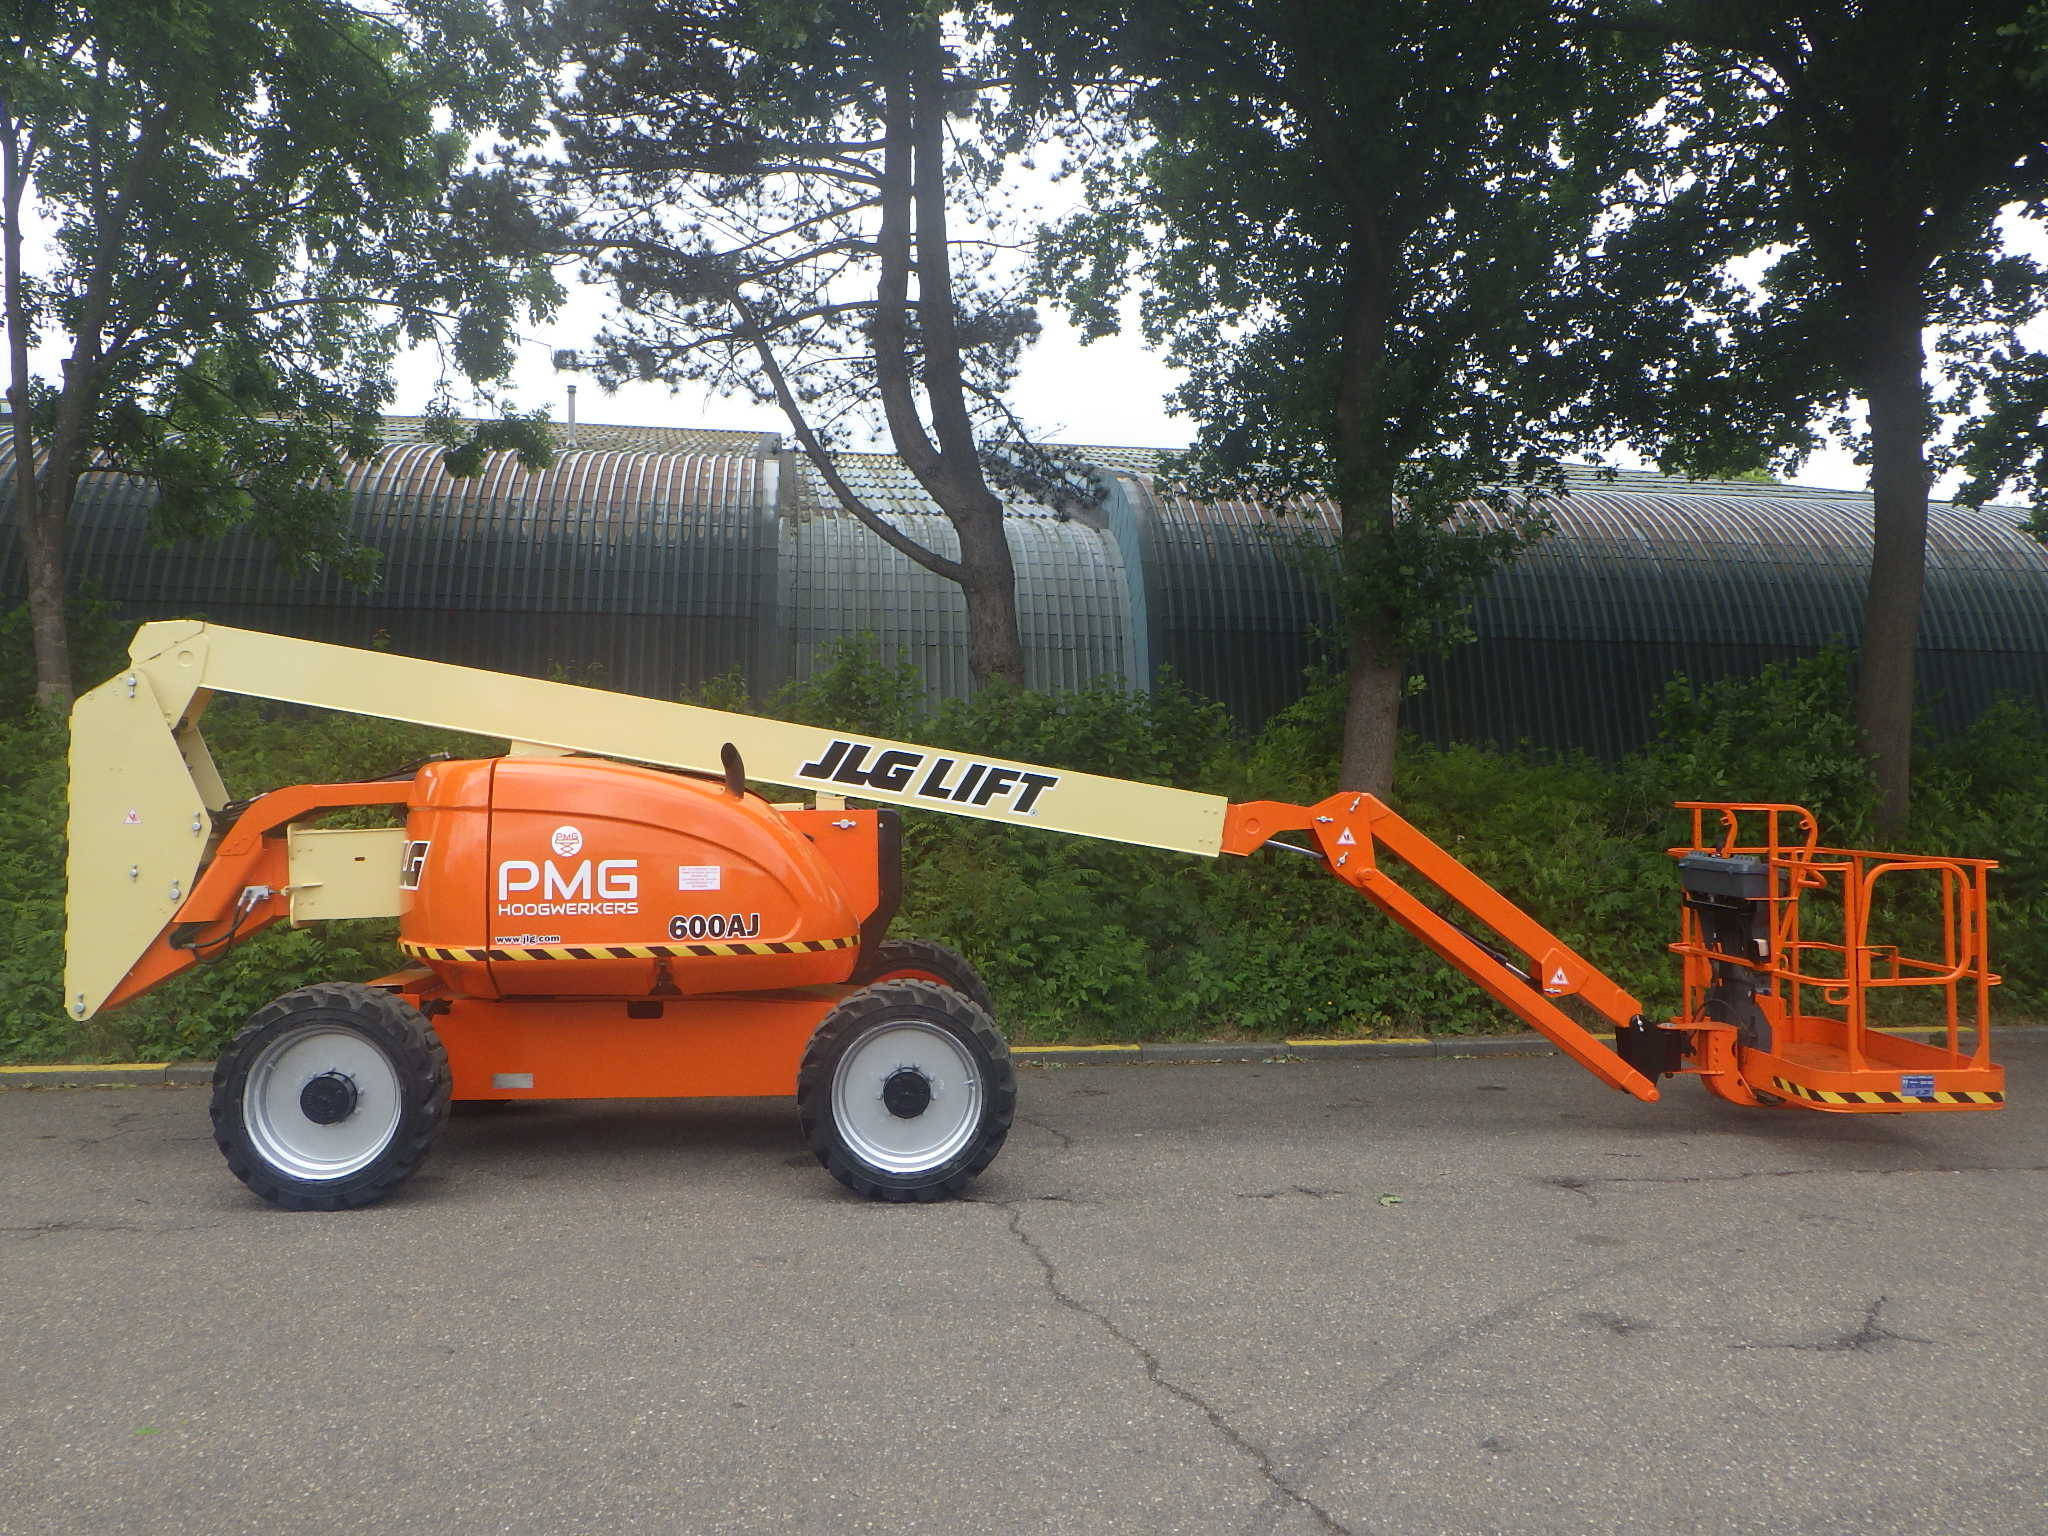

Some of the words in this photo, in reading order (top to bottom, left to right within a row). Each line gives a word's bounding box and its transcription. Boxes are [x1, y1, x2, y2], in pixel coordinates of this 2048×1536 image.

[798, 739, 925, 794] JLG
[555, 832, 579, 841] PMG
[498, 859, 638, 900] PMG
[497, 902, 639, 916] HOOGWERKERS
[669, 913, 760, 940] 600AJ
[495, 934, 560, 944] www.jlg.com
